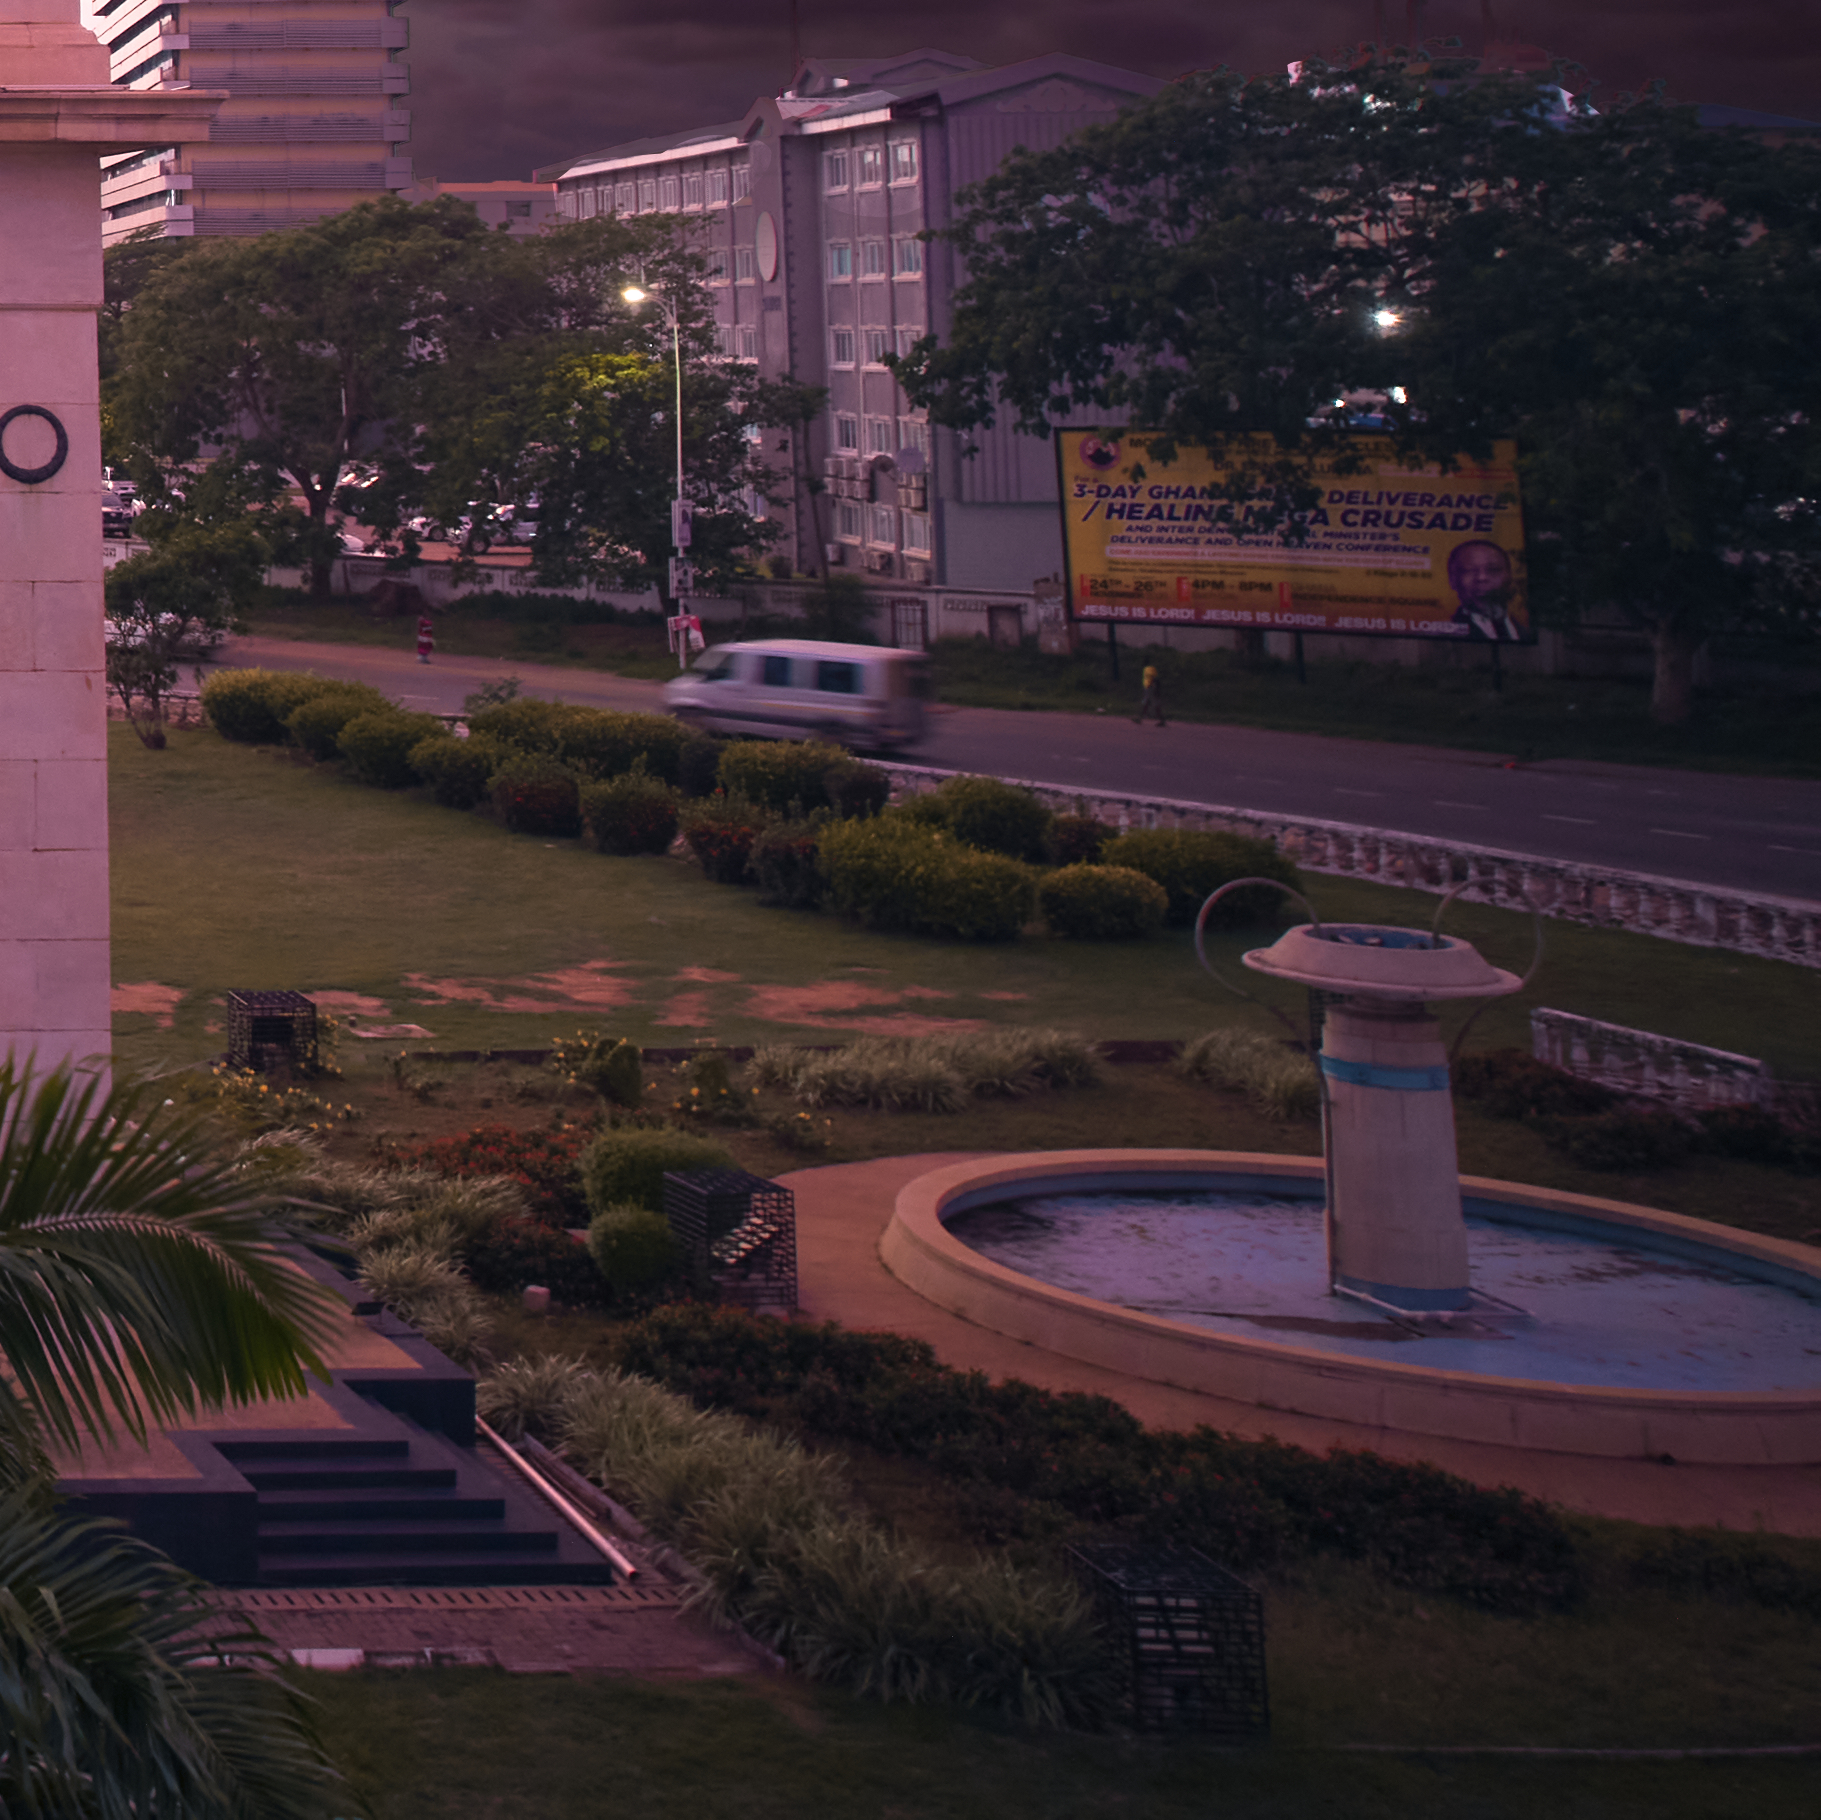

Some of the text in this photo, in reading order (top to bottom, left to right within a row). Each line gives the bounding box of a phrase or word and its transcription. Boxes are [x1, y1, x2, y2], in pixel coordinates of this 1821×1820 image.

[1073, 483, 1143, 499] 3-DAY
[1147, 484, 1229, 500] GHA
[1326, 490, 1508, 511] DELIVERANCE
[1125, 524, 1153, 534] AND
[1156, 525, 1195, 534] INTER
[1243, 504, 1329, 526] MGA
[1340, 508, 1496, 532] CRUSADE
[1110, 534, 1431, 554] DELIVERANCE AND OPEN HVEN CONFERENCE
[1192, 579, 1225, 590] 4PM
[1081, 604, 1129, 618] JESUS
[1131, 606, 1147, 618] IS
[1149, 607, 1196, 620] LORD!
[1201, 609, 1253, 622] JESUS
[1255, 611, 1272, 623] IS
[1334, 616, 1387, 630] JESUS
[1389, 618, 1407, 631] IS
